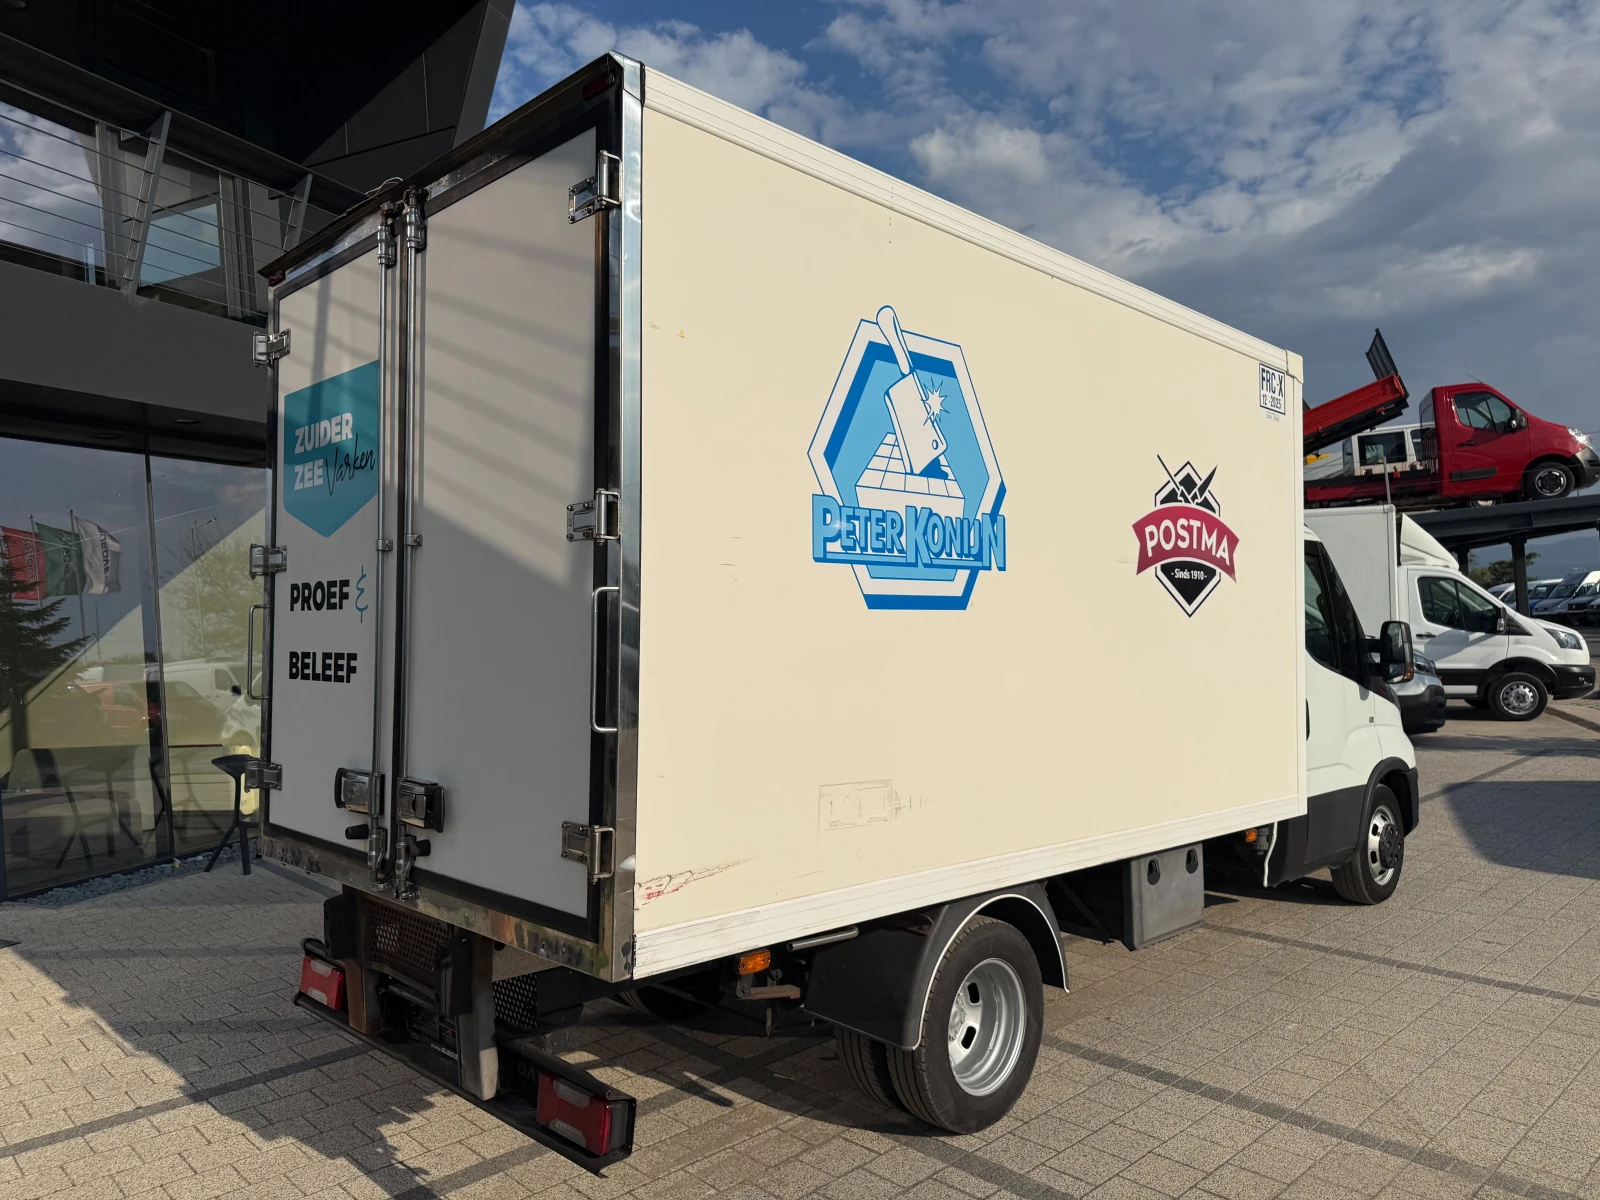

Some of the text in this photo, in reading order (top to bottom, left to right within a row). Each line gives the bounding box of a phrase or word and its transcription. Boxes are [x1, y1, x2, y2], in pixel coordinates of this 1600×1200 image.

[294, 412, 353, 455] ZUIDER
[293, 433, 376, 497] ZEE Varken
[1144, 517, 1230, 567] POSTMA
[290, 579, 350, 611] PROEF
[289, 651, 357, 684] BELEEF
